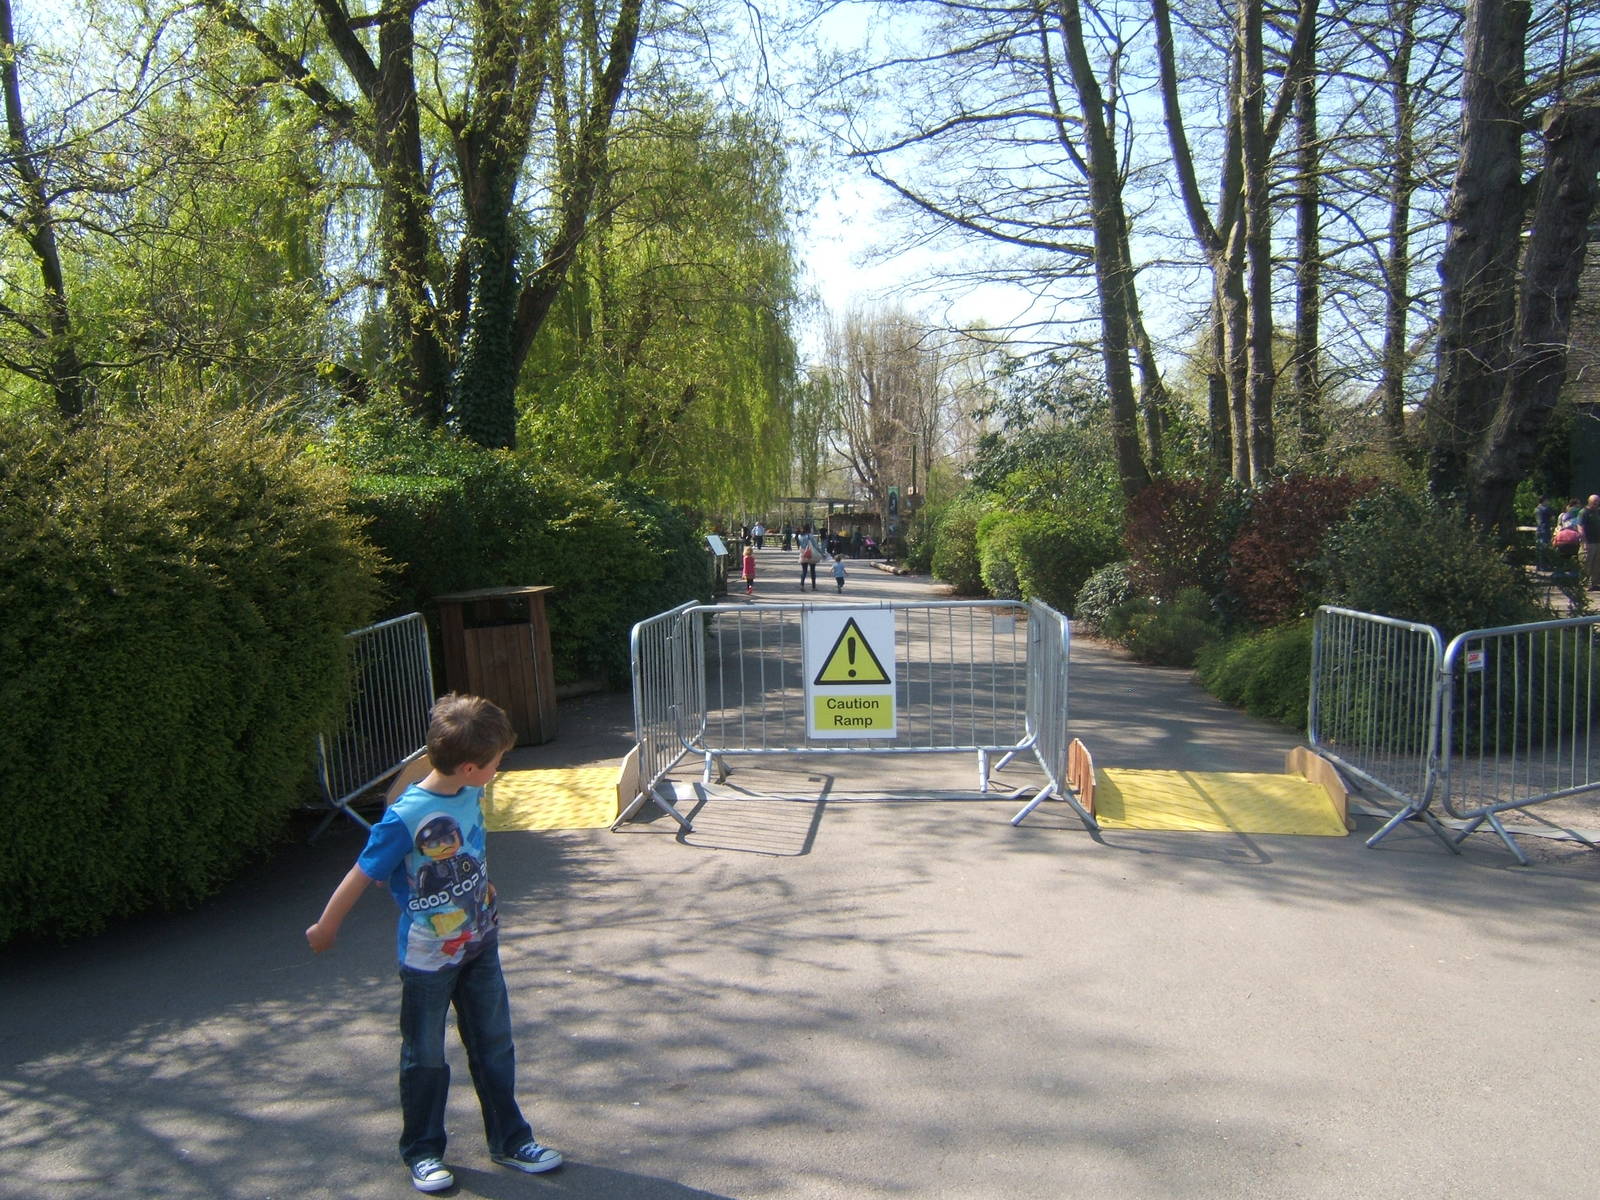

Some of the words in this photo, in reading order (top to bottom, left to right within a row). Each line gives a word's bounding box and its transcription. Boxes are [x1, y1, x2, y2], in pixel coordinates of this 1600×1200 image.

[826, 698, 879, 710] Caution
[834, 715, 873, 728] Ramp
[408, 890, 450, 911] GOOD
[452, 873, 480, 897] COP
